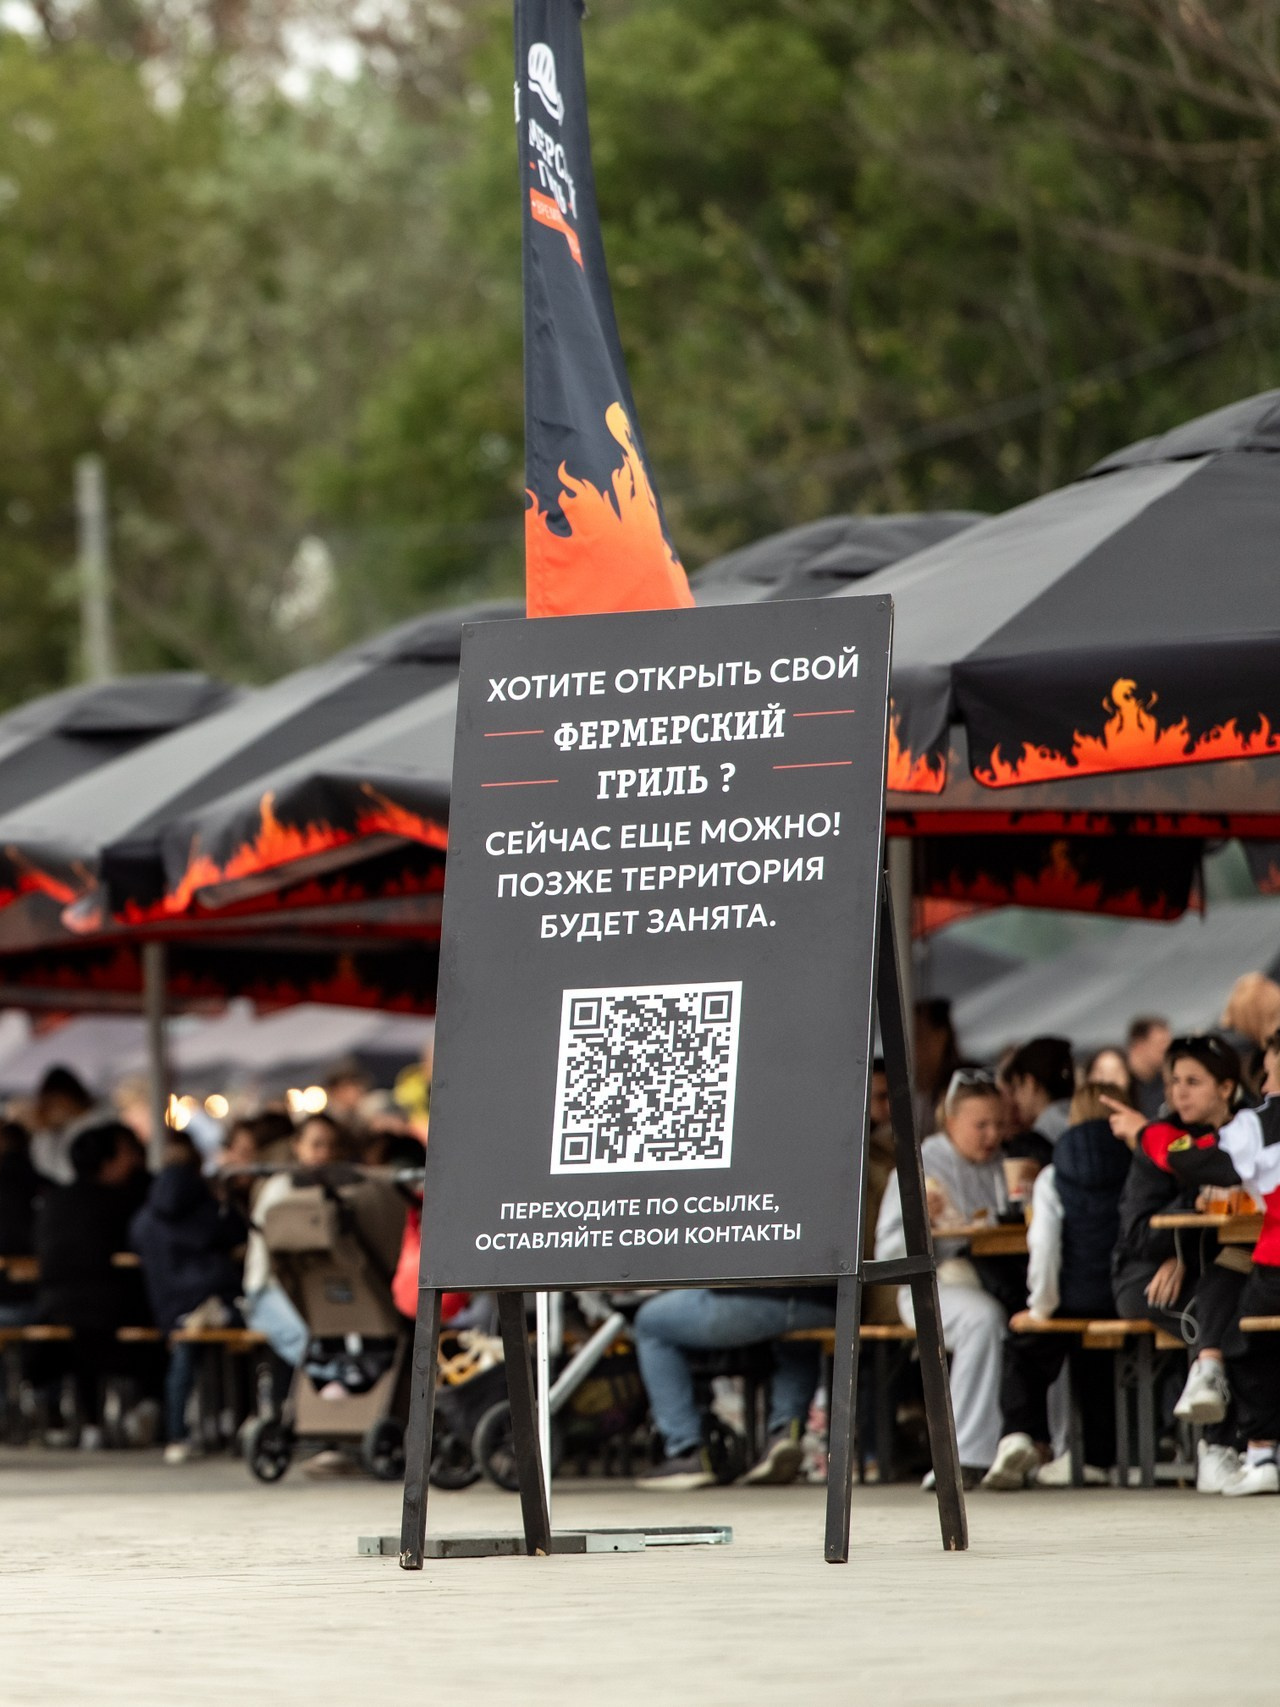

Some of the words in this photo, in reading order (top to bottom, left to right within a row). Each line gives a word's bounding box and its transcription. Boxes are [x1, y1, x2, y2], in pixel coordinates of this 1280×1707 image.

[486, 670, 607, 703] ХОТИТЕ
[614, 660, 762, 694] ОТКРЫТЬ
[769, 645, 859, 683] СВОЙ
[553, 702, 786, 752] ФЕРМЕРСКИЙ
[596, 764, 709, 800] ГРИЛЬ
[719, 762, 736, 793] ?
[485, 821, 612, 856] СЕЙЧАС
[620, 821, 692, 852] ЕЩЕ
[700, 811, 841, 845] МОЖНО!
[497, 868, 613, 898] ПОЗЖЕ
[621, 856, 824, 892] ТЕРРИТОРИЯ
[540, 910, 640, 943] БУДЕТ
[646, 903, 776, 934] ЗАНЯТА.
[500, 1198, 641, 1221] ПЕРЕХОДИТЕ
[646, 1197, 679, 1216] ПО
[683, 1193, 780, 1214] ССЫЛКЕ,
[475, 1225, 614, 1251] ОСТАВЛЯЙТЕ
[618, 1227, 679, 1247] СВОИ
[684, 1223, 801, 1244] КОНТАКТЫ
